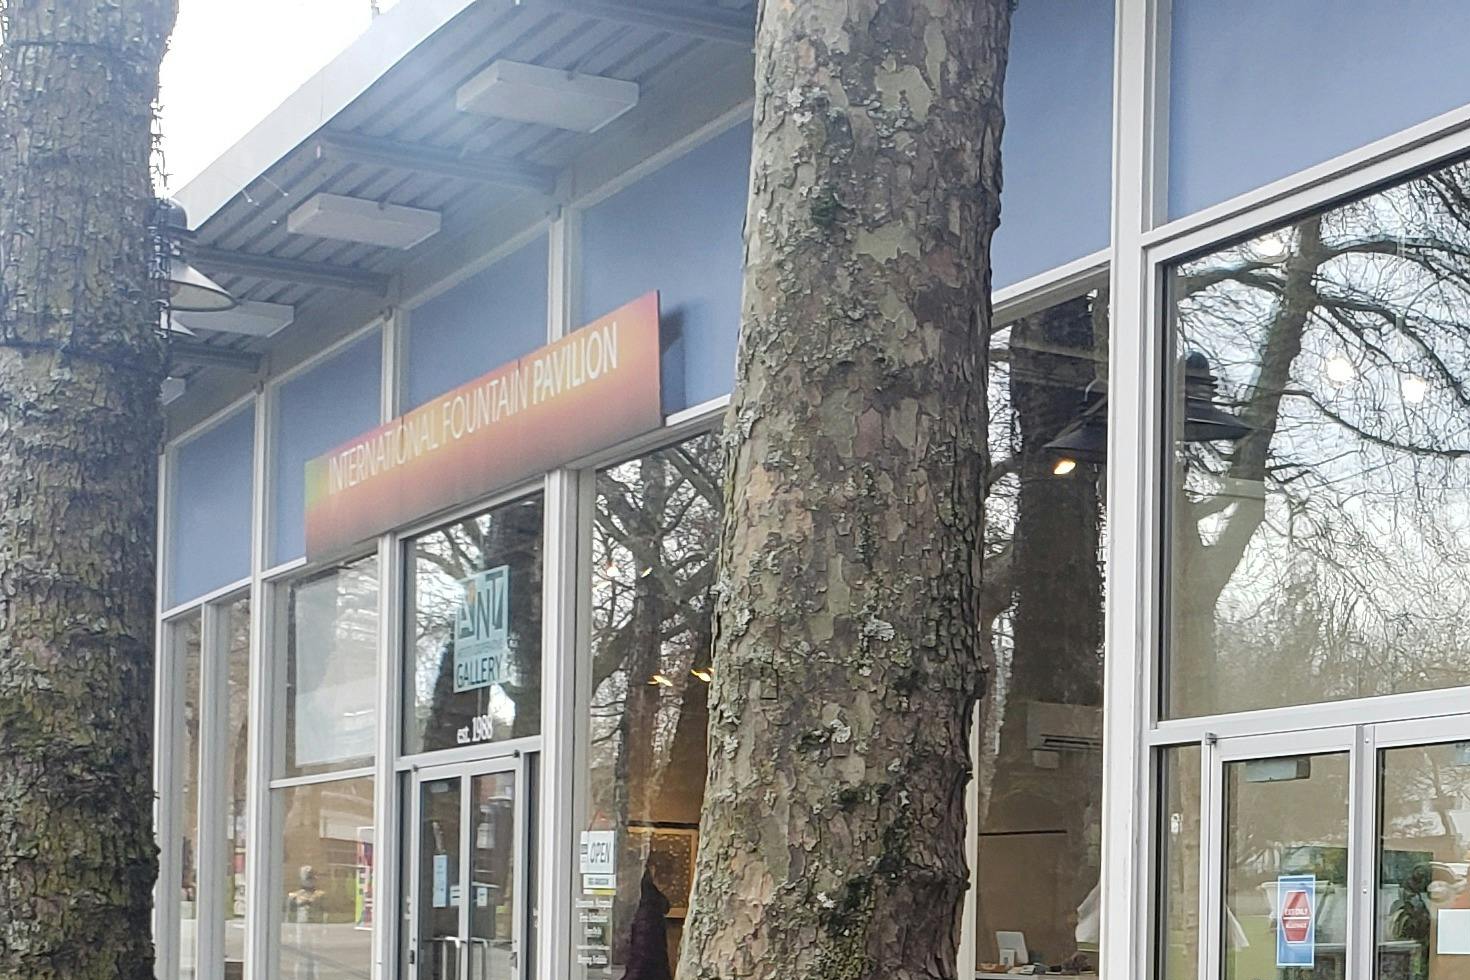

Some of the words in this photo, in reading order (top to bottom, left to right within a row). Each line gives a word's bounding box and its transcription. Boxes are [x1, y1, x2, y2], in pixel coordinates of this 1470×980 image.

[328, 409, 440, 496] INTERNATIONAL
[442, 366, 529, 445] FOUNTAIN
[533, 321, 618, 405] PAVILION
[456, 654, 502, 688] GALLERY
[472, 715, 493, 742] 1988
[589, 841, 611, 864] OPEN
